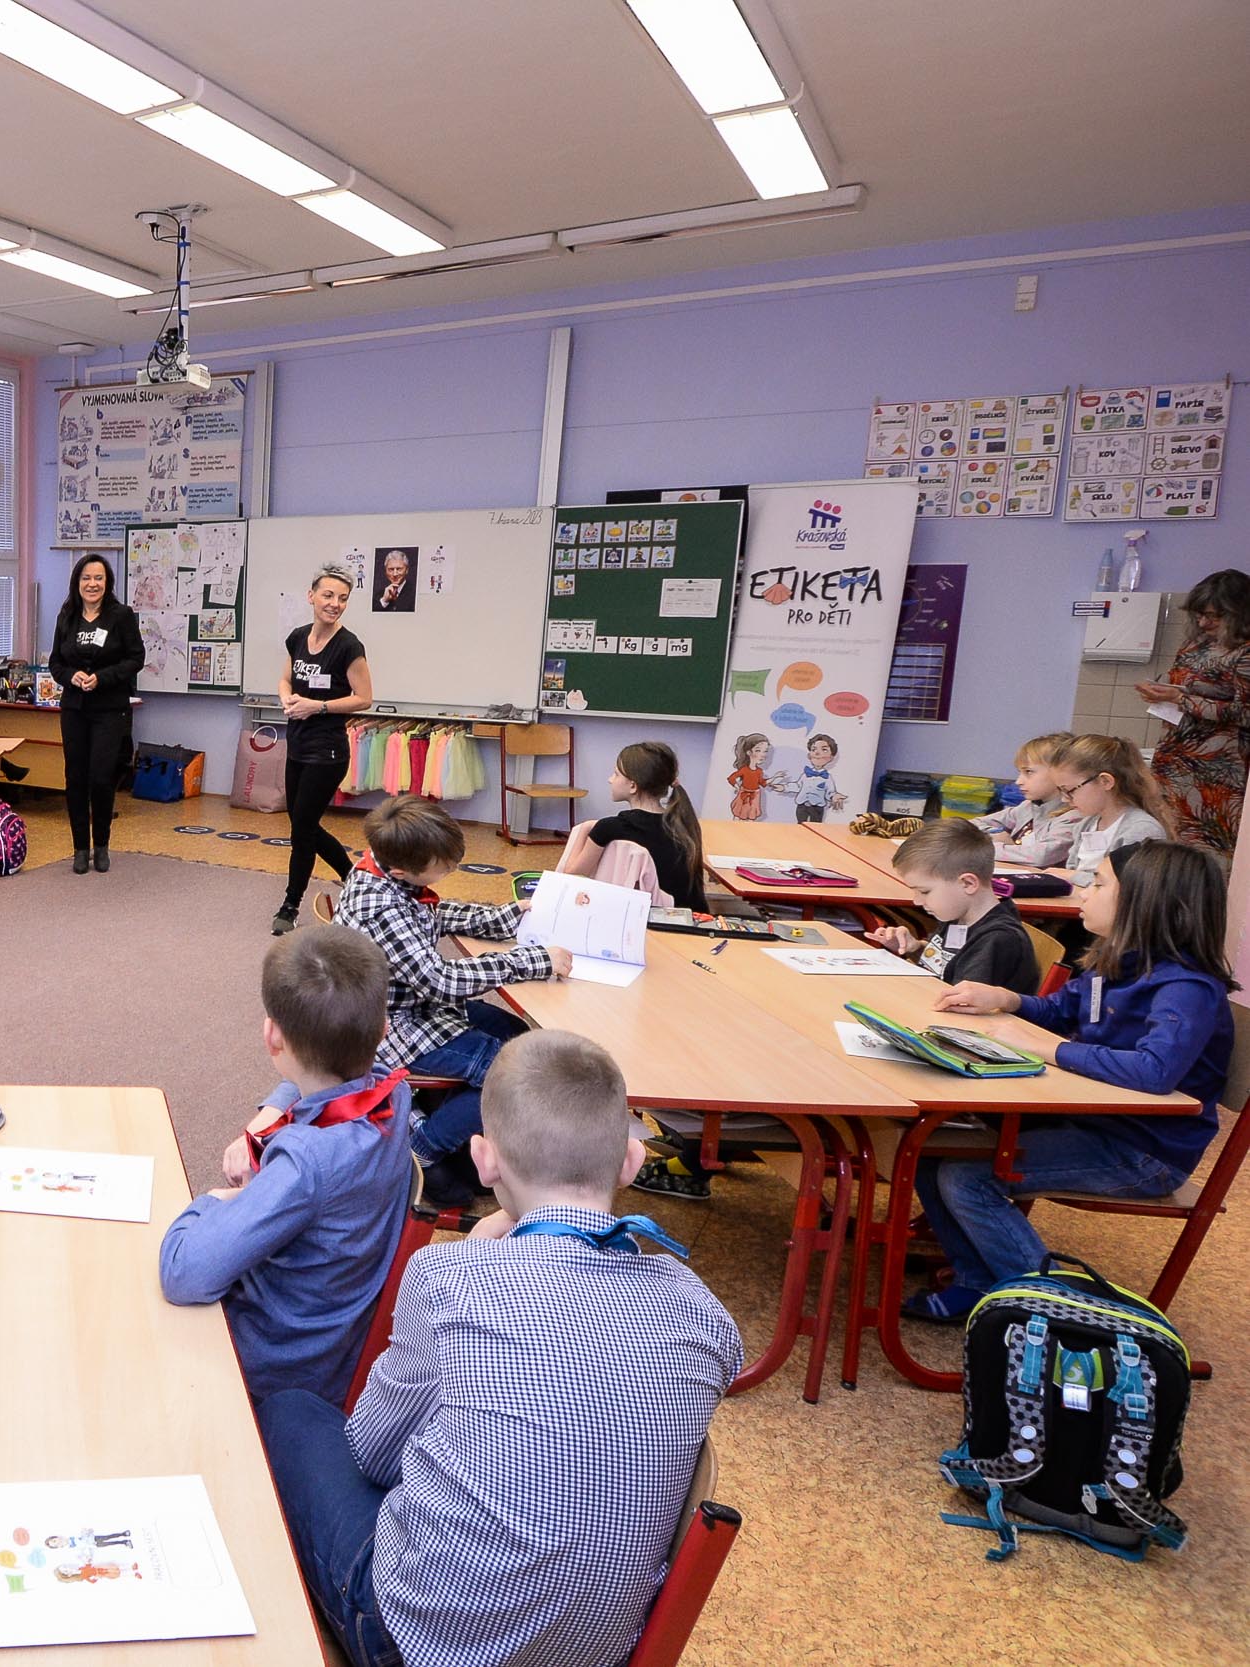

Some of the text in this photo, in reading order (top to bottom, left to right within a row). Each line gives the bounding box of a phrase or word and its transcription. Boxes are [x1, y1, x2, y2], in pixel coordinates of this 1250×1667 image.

[81, 388, 138, 407] VYJMENOVANÁ
[1175, 399, 1204, 409] PAPÍR
[1095, 405, 1125, 415] LÁTKA
[1098, 450, 1116, 458] KOV
[1171, 445, 1201, 455] DŘEVO
[1092, 493, 1113, 501] SKLO
[1166, 492, 1195, 500] PLAST
[796, 528, 848, 543] Krašovská
[750, 566, 883, 604] ETIKETA
[787, 602, 852, 625] PRO DĚTI
[624, 640, 637, 652] kg
[651, 642, 659, 652] g
[670, 643, 688, 653] mg
[244, 761, 257, 803] LAUNDRY
[467, 865, 495, 873] 4
